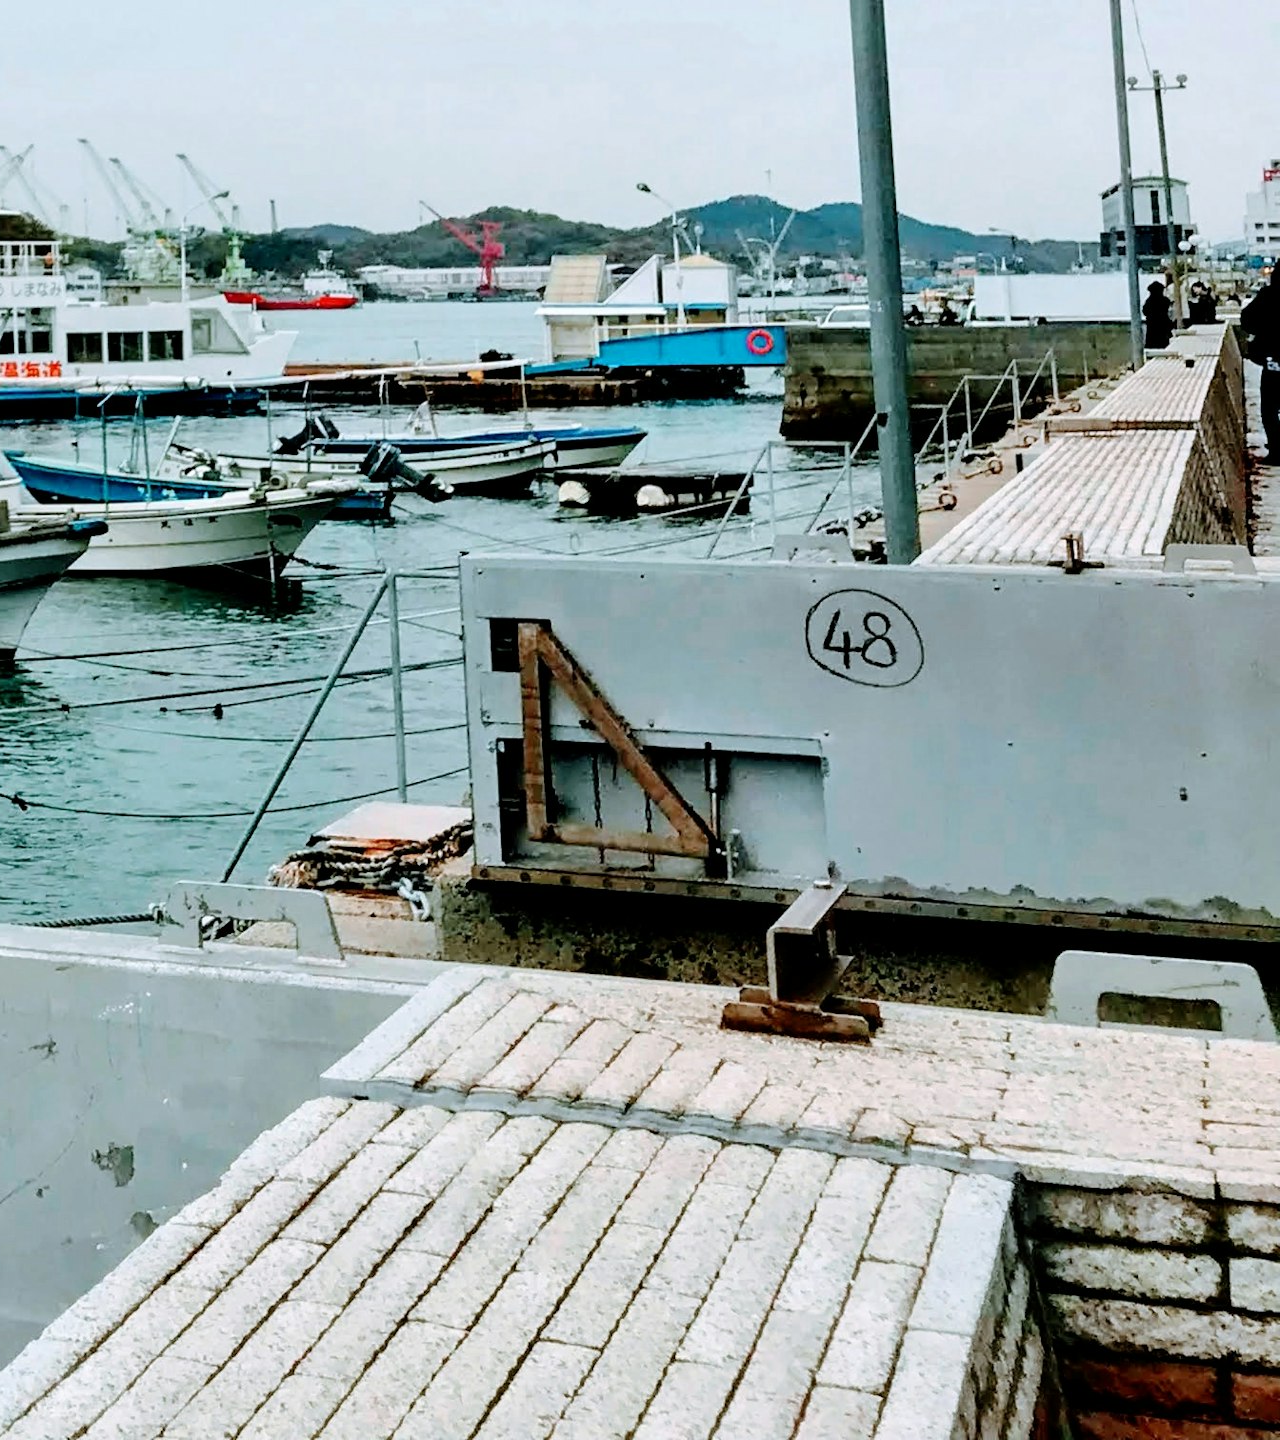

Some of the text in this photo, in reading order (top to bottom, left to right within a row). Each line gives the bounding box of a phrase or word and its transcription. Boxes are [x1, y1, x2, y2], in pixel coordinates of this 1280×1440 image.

[11, 281, 62, 298] しまなみ
[823, 608, 897, 669] 48
